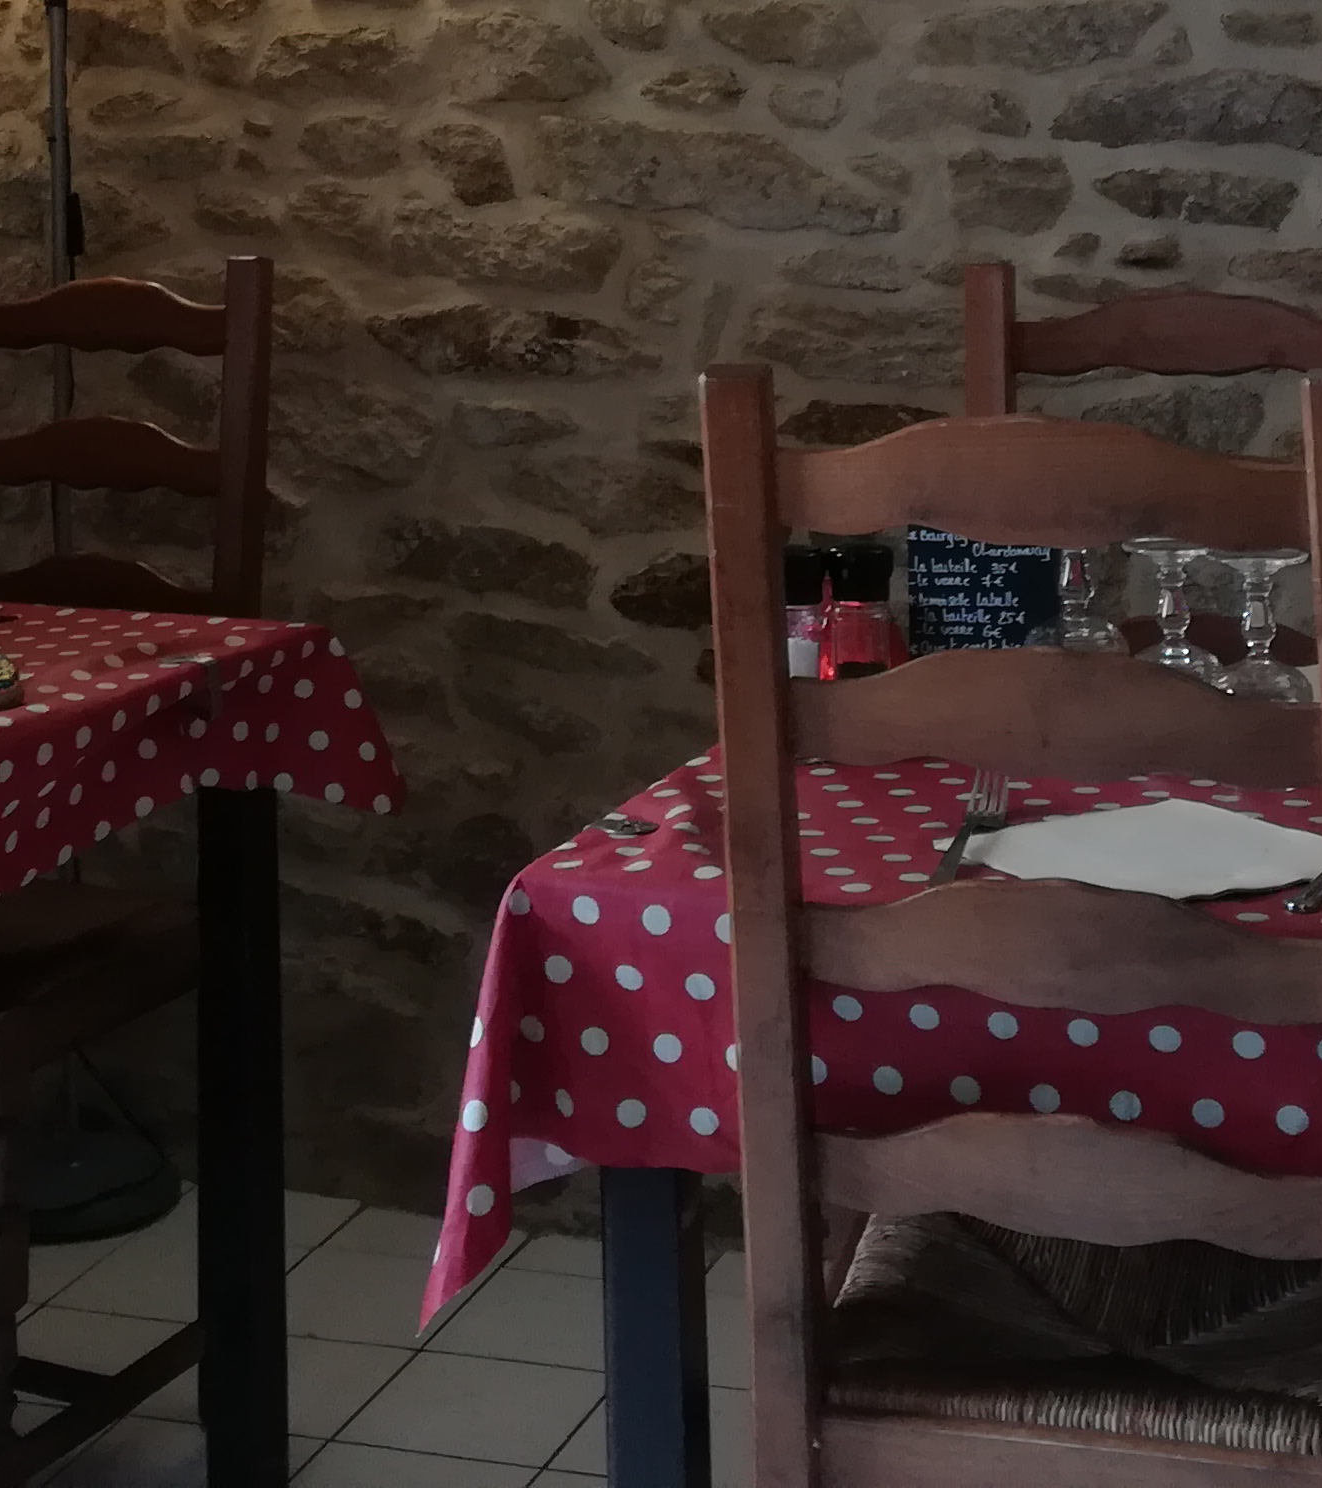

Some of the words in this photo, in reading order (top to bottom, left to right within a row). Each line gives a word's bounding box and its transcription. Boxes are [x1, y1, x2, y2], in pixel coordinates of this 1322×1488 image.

[931, 557, 978, 574] bouteille
[934, 576, 971, 587] verre
[942, 608, 991, 624] bouteille
